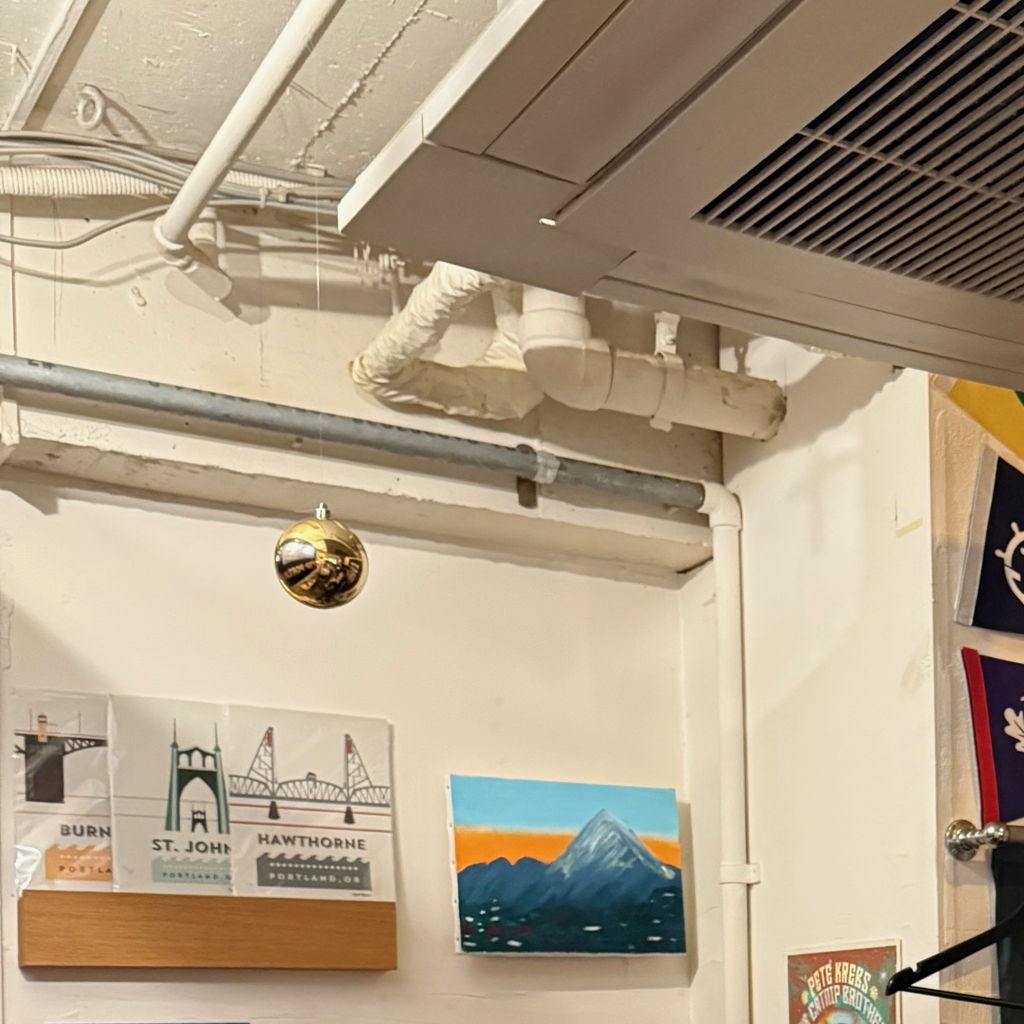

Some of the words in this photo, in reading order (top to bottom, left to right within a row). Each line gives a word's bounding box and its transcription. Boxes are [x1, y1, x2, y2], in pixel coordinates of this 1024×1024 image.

[60, 824, 112, 838] BURN
[151, 838, 180, 853] ST.
[257, 833, 368, 850] HAWTHORNE
[807, 961, 833, 998] PETE
[834, 961, 872, 994] KREBS
